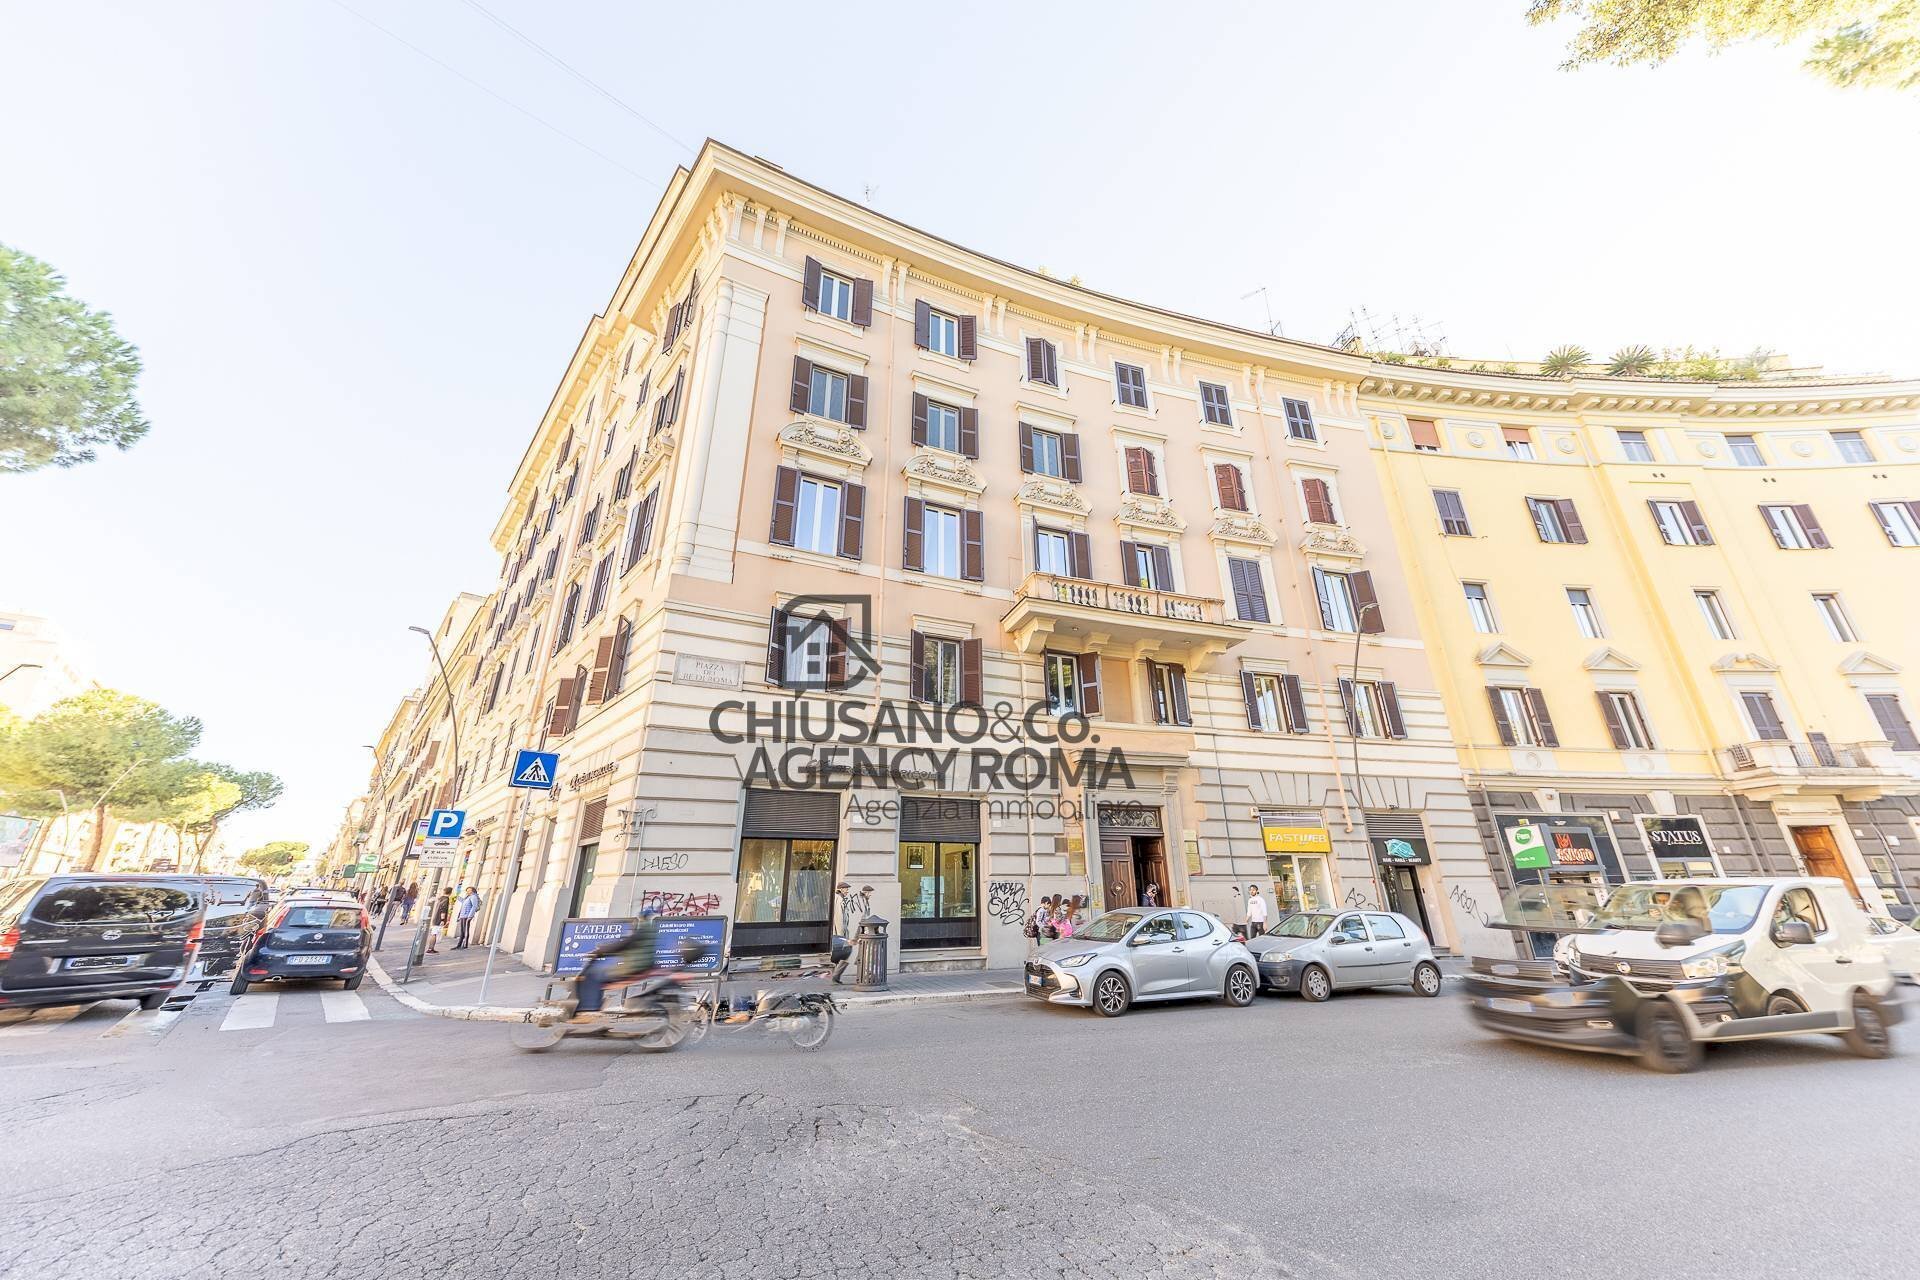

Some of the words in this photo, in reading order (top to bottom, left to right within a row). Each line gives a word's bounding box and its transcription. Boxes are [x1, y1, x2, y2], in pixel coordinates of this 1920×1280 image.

[696, 662, 725, 671] PIAZZA
[708, 675, 733, 684] ROMA
[433, 812, 459, 835] P
[1269, 833, 1327, 843] FASTWEB
[1652, 830, 1702, 844] STATUS
[574, 924, 622, 934] L'ATELIER
